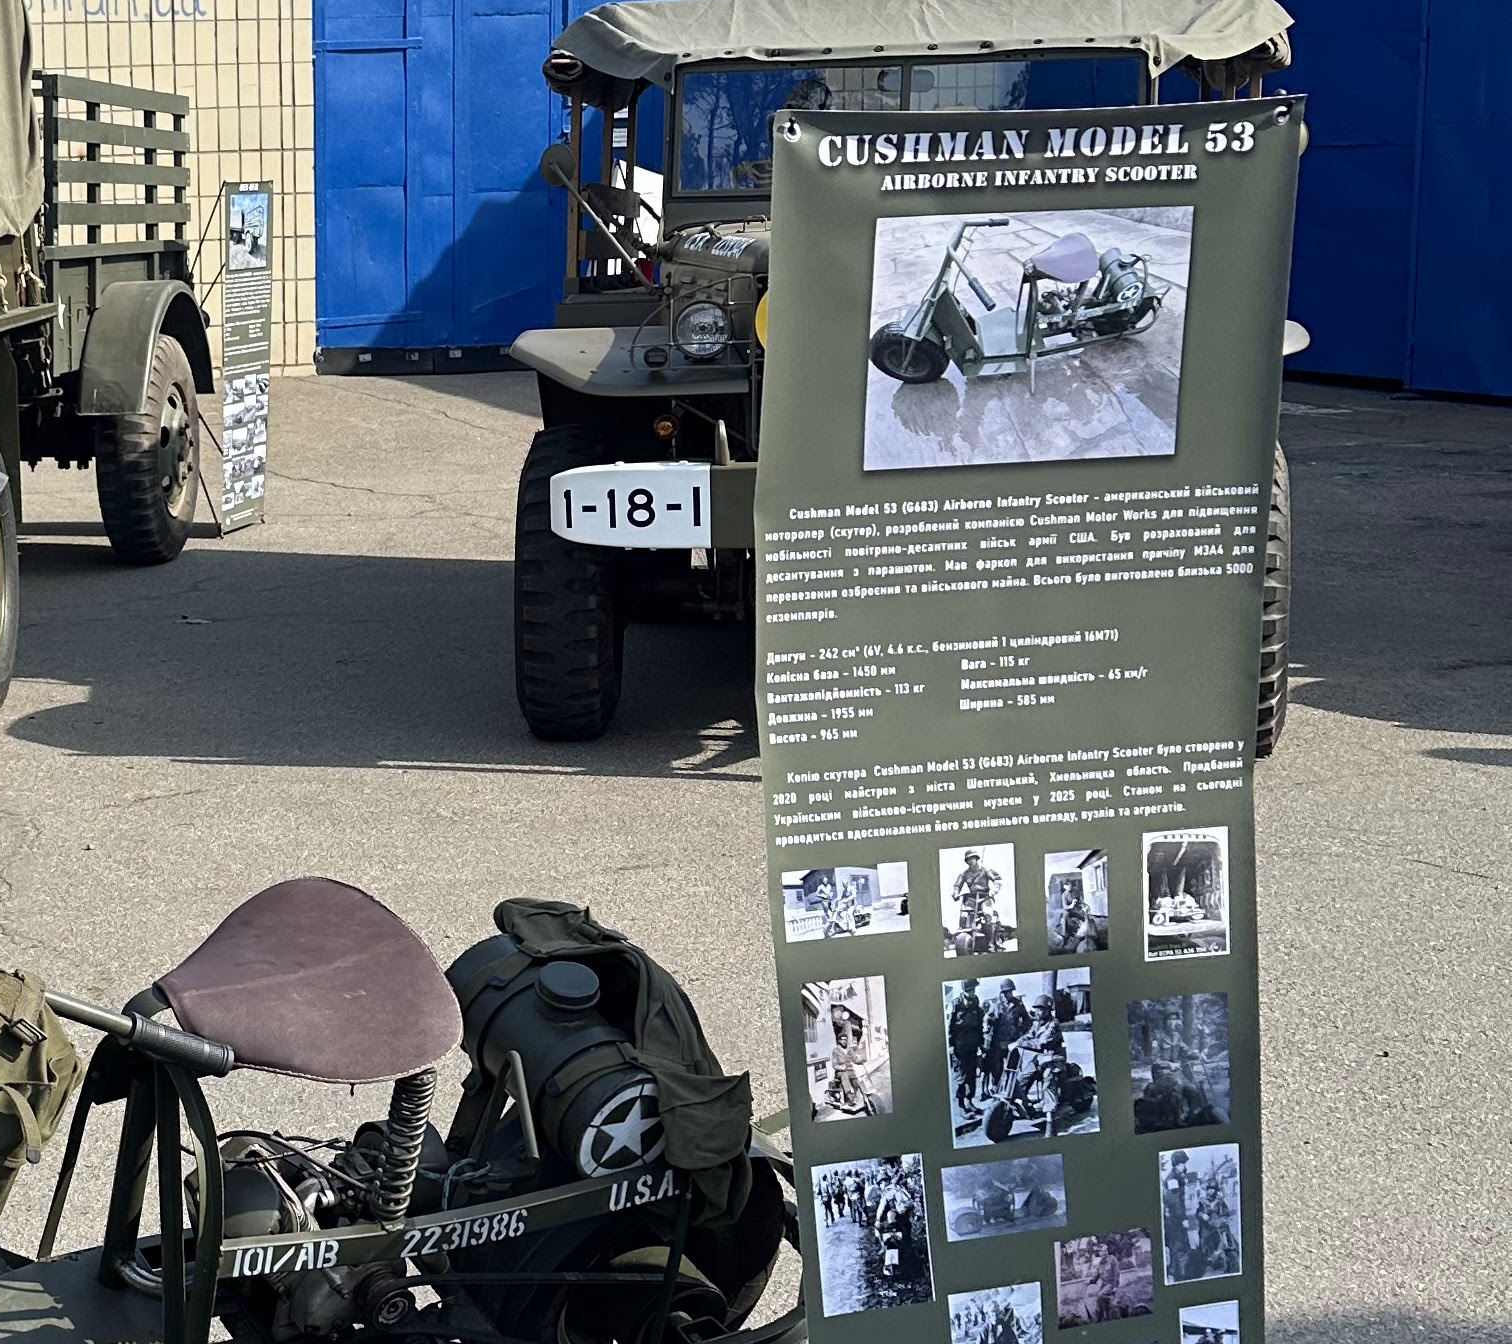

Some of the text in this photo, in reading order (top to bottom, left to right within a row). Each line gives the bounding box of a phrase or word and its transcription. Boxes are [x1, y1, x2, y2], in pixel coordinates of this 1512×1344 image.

[818, 121, 1256, 167] CUSHMAN MODEL 53
[881, 163, 1197, 191] AIRBORNE INFANTRY SCOOTER
[790, 483, 1259, 520] Cushman Model 53 (G683) Airborne Infantry Scooter американський військовий
[765, 506, 1257, 542] моторолер (скутер), розроблений компанією Cushman Motor Works для підвищення
[766, 547, 831, 562] мобільності
[845, 541, 967, 557] повітряно-десантних
[980, 536, 1016, 549] військ
[1029, 533, 1057, 548] армії
[1111, 530, 1130, 543] Був
[1143, 524, 1221, 541] розрахований
[1233, 525, 1256, 536] для
[766, 569, 843, 584] десантування
[868, 564, 935, 577] парашютом.
[945, 559, 967, 571] Мав
[976, 558, 1017, 571] фаркоп
[1026, 556, 1047, 568] для
[1056, 551, 1133, 565] використання
[1232, 545, 1254, 556] для
[766, 589, 837, 604] перевезення
[842, 586, 900, 599] озброєння
[905, 584, 917, 594] та
[922, 580, 988, 593] військового
[992, 576, 1029, 588] майна.
[1034, 574, 1071, 586] Всього
[1076, 572, 1101, 585] було
[1105, 569, 1174, 581] виготовлено
[1226, 562, 1253, 575] 5000
[766, 608, 838, 623] екземплярів.
[767, 652, 805, 666] Двигун
[819, 647, 838, 660] 242
[887, 643, 903, 655] 4.6
[933, 636, 998, 652] бензиновий
[1010, 631, 1081, 647] циліндровий
[961, 656, 1030, 671] Вага 115 кг
[767, 665, 895, 684] Колісна база 1450 мм
[961, 677, 1035, 690] Максимальна
[1038, 671, 1095, 685] швидкість
[1108, 668, 1121, 680] 65
[767, 682, 925, 704] Вантажопідйомність 113 кг
[960, 694, 1054, 711] Ширина 585 мм
[768, 707, 873, 726] Довжина 1955 мм
[769, 728, 857, 745] Висота 965 мм
[787, 771, 820, 784] Копію
[824, 769, 866, 782] скутера
[874, 764, 923, 776] Cushman
[927, 759, 959, 772] Model
[963, 757, 975, 770] 53
[979, 755, 1013, 770] (G683)
[1017, 754, 1063, 765] Airborne
[1068, 749, 1109, 761] Infantry
[1113, 746, 1153, 758] Scooter
[1157, 744, 1181, 757] було
[1185, 741, 1234, 753] створено
[773, 792, 796, 806] 2020
[809, 790, 832, 804] році
[845, 786, 896, 799] майстром
[927, 781, 955, 792] міста
[1183, 757, 1243, 773] Придбаний
[774, 812, 841, 826] Українським
[853, 801, 973, 818] військово-історичним
[984, 796, 1022, 809] музеєм
[1050, 789, 1075, 802] 2025
[1086, 787, 1112, 802] році.
[1123, 785, 1162, 796] Станом
[1173, 783, 1186, 792] на
[1197, 777, 1242, 791] сьогодні
[776, 831, 844, 847] проводиться
[848, 824, 931, 840] вдосконалення
[935, 820, 959, 832] його
[963, 816, 1029, 830] зовнішнього
[1118, 807, 1130, 816] та
[1134, 802, 1186, 816] агрегатів.
[608, 1169, 681, 1211] U.S.A.
[400, 1209, 529, 1258] 2231986
